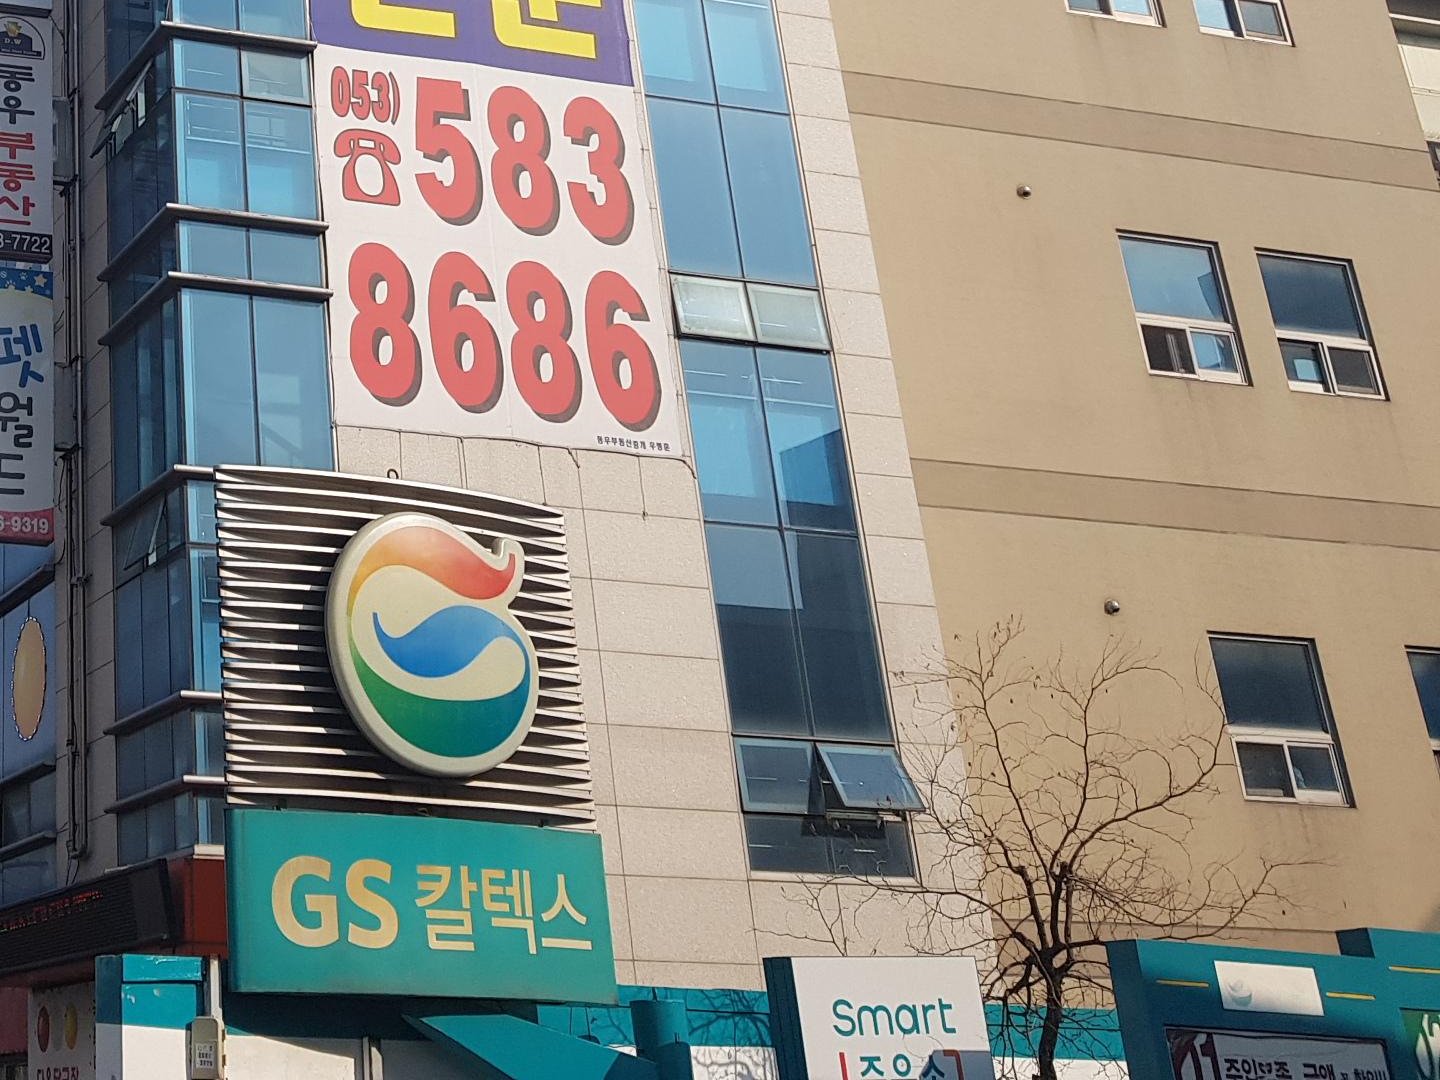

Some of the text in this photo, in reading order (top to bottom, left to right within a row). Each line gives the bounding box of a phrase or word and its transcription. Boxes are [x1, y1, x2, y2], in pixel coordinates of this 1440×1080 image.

[330, 65, 401, 125] 053)
[415, 76, 635, 246] 583
[348, 242, 663, 432] 8686
[271, 855, 593, 956] GS 칼텍스
[832, 998, 957, 1037] Smart
